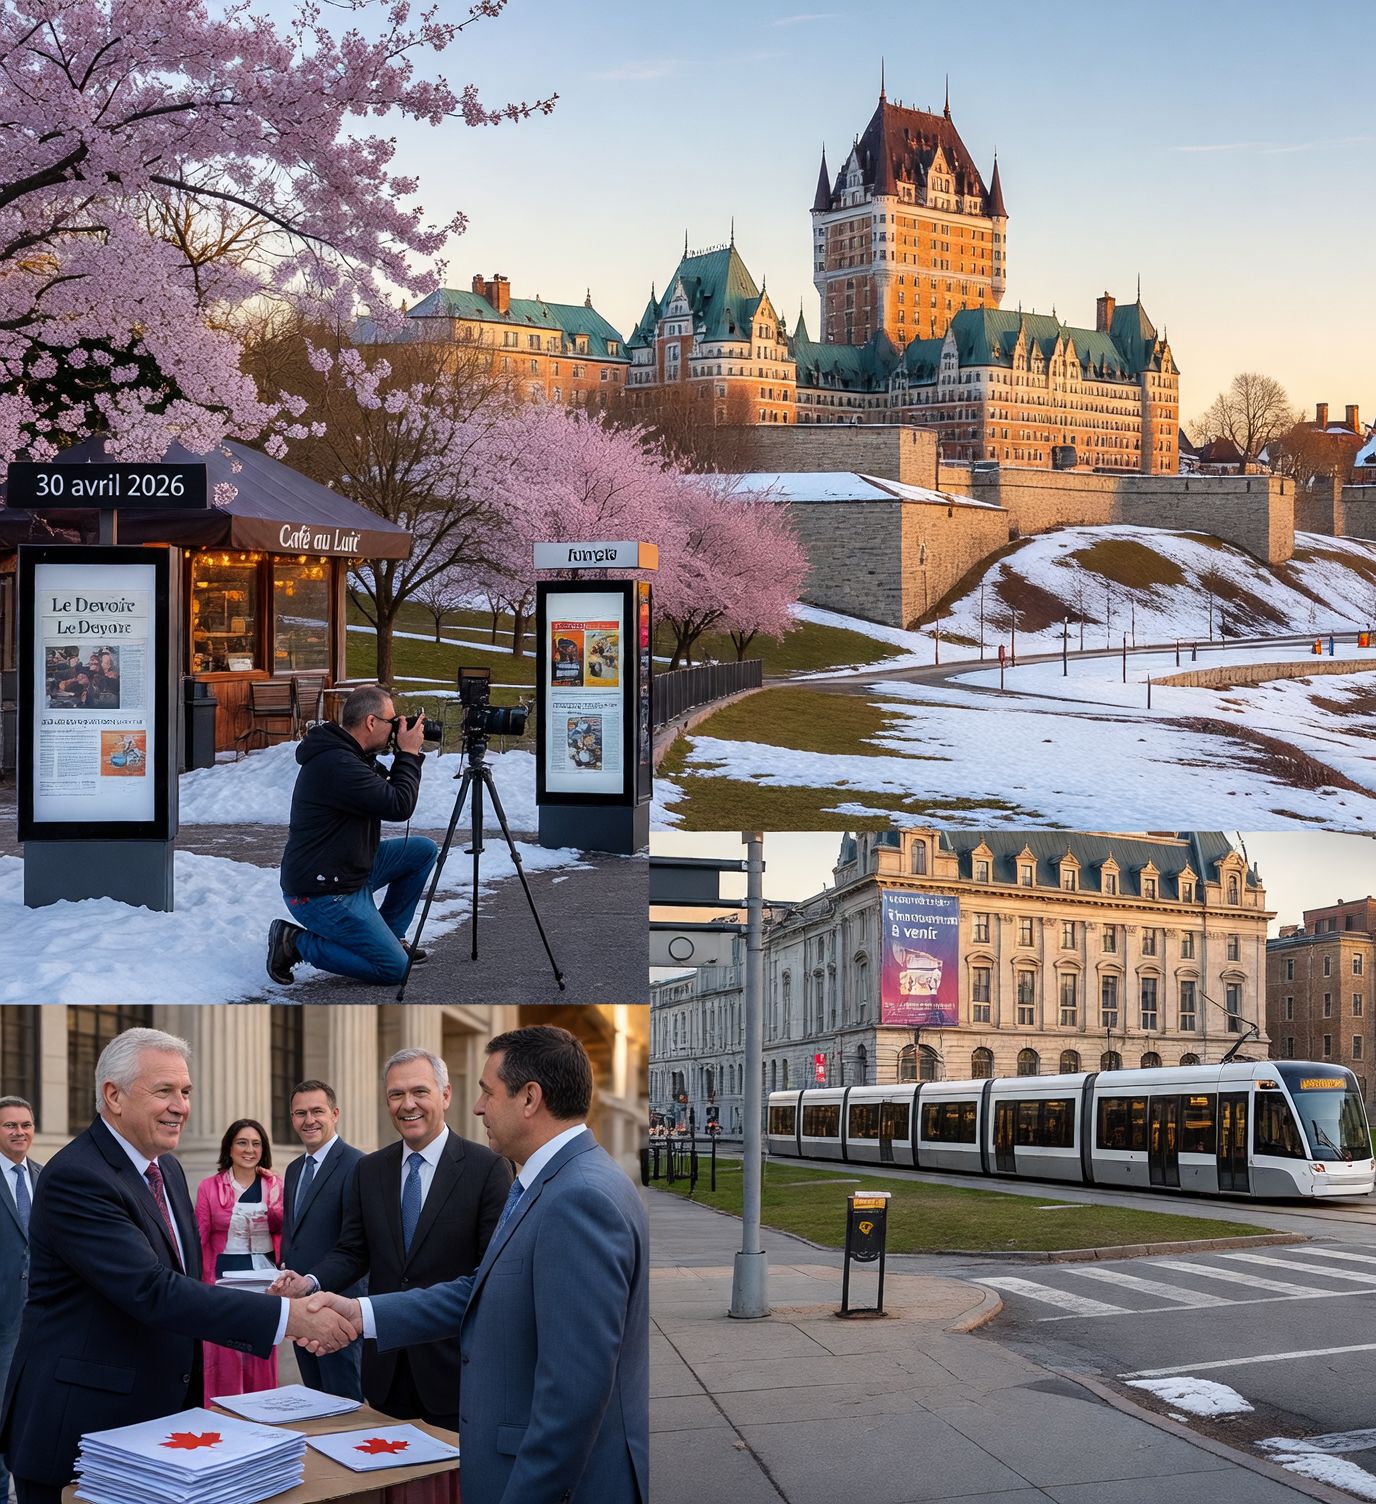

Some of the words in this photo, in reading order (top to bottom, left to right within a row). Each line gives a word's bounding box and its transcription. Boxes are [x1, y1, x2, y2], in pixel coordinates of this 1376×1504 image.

[35, 474, 64, 497] 30
[71, 473, 120, 497] avril
[127, 474, 185, 497] 2026
[279, 524, 311, 550] Café
[313, 533, 331, 550] au
[52, 597, 72, 612] Le
